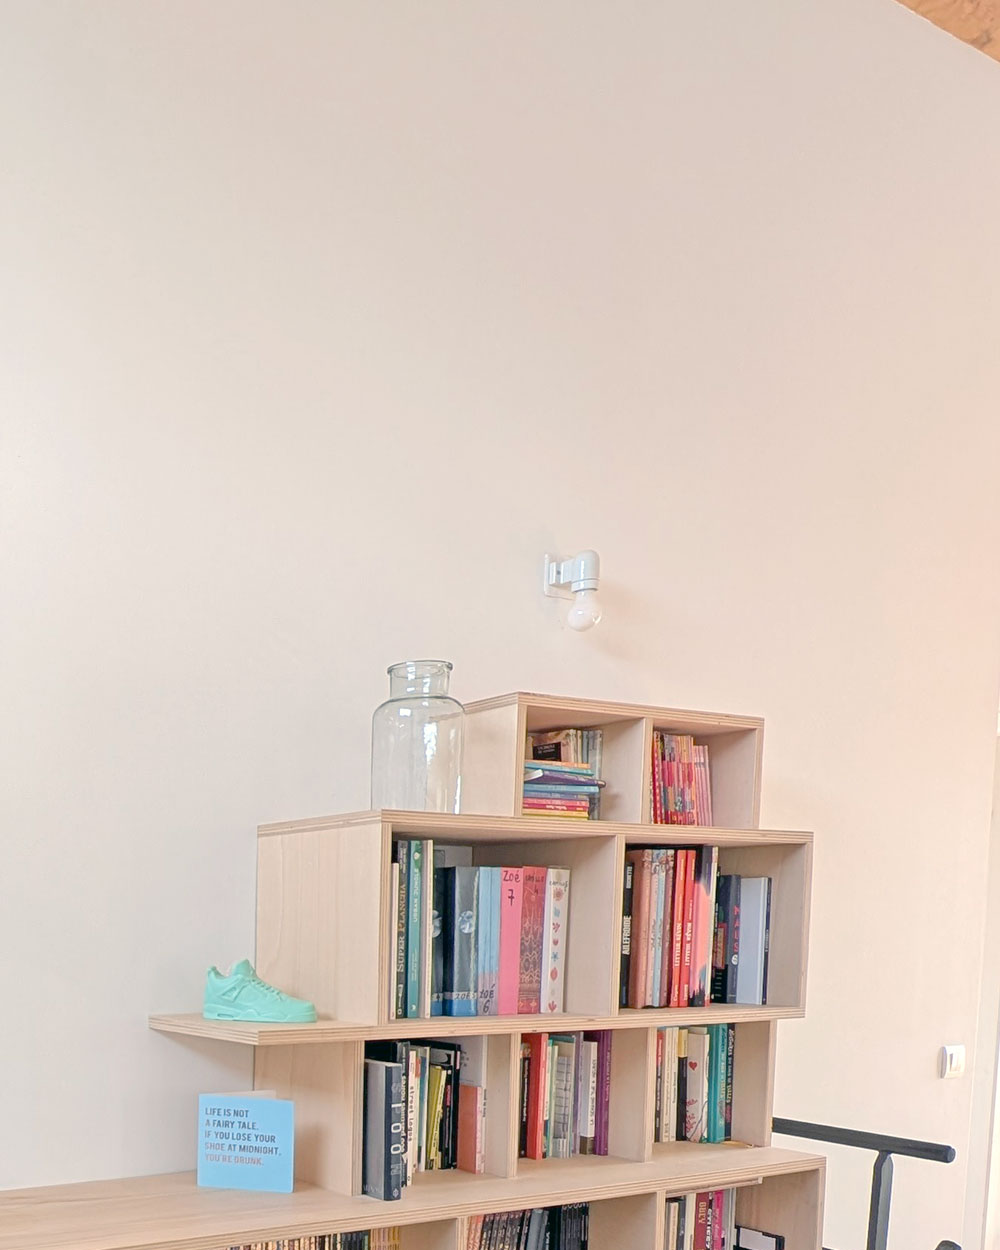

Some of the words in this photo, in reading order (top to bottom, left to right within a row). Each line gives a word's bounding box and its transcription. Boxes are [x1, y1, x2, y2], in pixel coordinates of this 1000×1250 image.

[503, 870, 520, 882] Zoé
[508, 889, 514, 906] 7
[622, 915, 631, 955] AILEFROIDE
[397, 936, 405, 972] SUPER
[483, 1000, 490, 1013] 6
[205, 1108, 222, 1116] LIFE
[224, 1108, 231, 1117] IS
[233, 1109, 249, 1118] NOT
[212, 1120, 235, 1129] FAIRY
[238, 1121, 259, 1130] TALE.
[391, 1082, 402, 1176] SPOON
[205, 1130, 211, 1139] IF
[214, 1131, 230, 1140] YOU
[232, 1132, 252, 1142] LOSE
[254, 1134, 276, 1143] YOUR
[205, 1142, 225, 1151] SHOE
[228, 1144, 237, 1152] AT
[239, 1144, 282, 1156] MIDNIGHT.
[234, 1155, 264, 1166] DRUNK.
